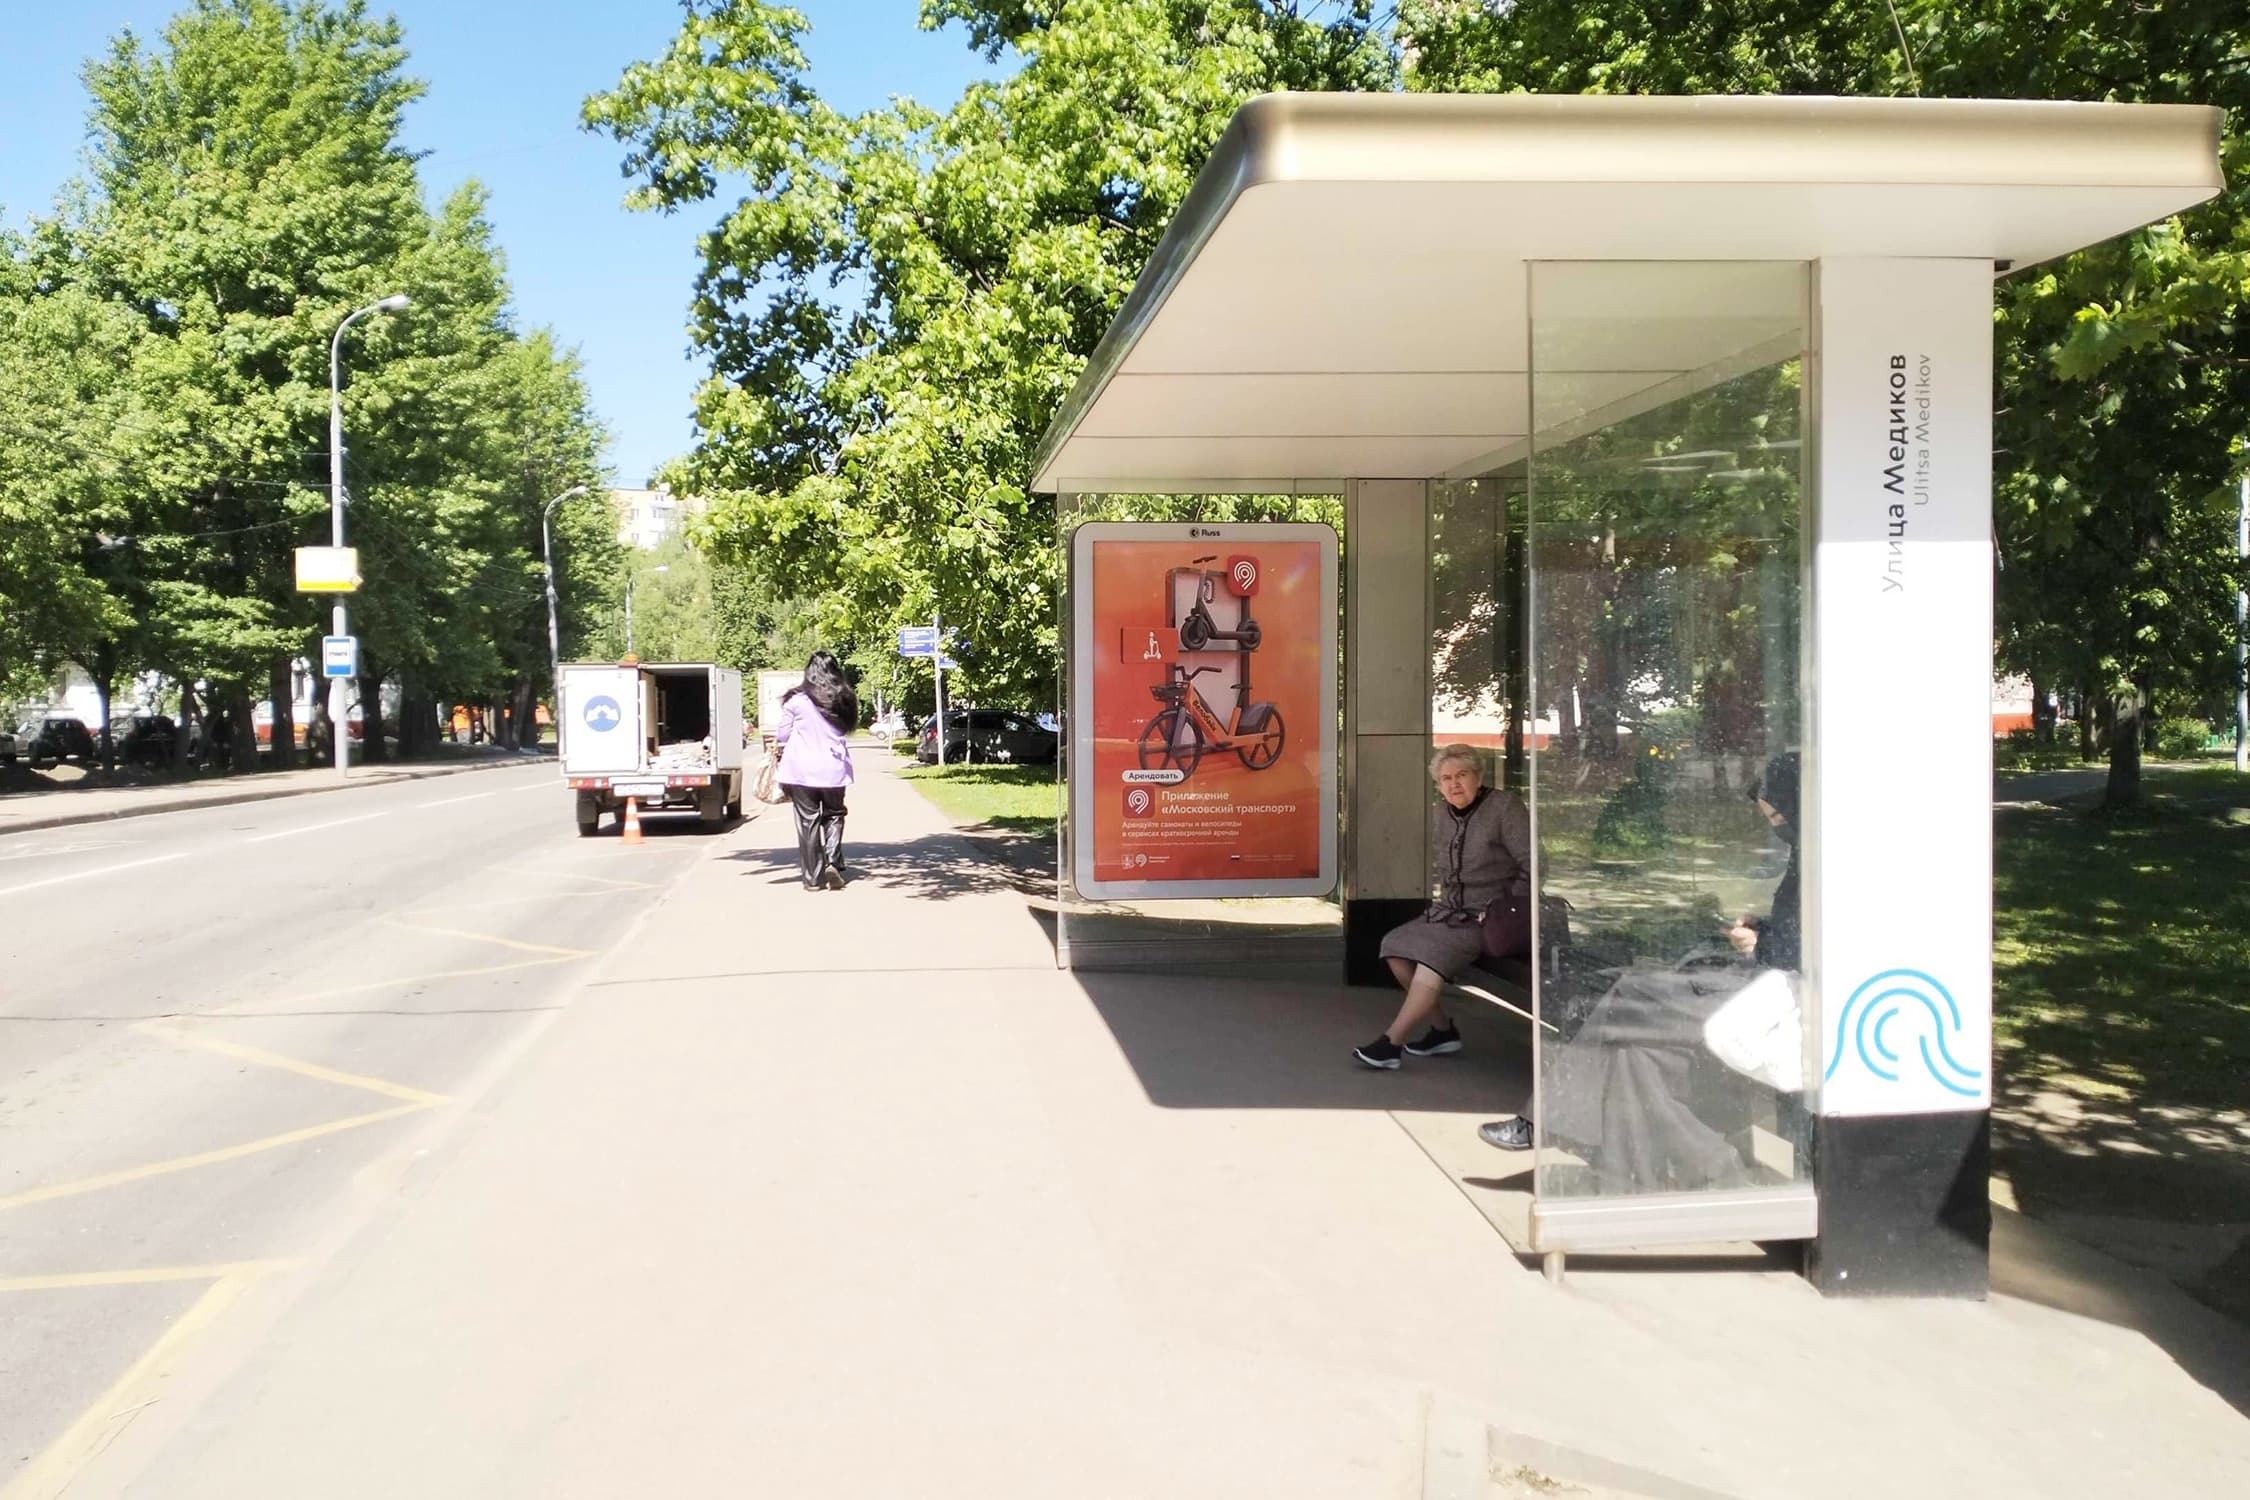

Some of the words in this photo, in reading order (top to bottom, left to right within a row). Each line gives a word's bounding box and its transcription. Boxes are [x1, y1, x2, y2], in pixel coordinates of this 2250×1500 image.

[1883, 354, 1909, 495] Медиков
[1915, 354, 1932, 442] Medikov
[1914, 448, 1930, 505] Ulitsa
[1201, 528, 1221, 537] Russ
[1882, 503, 1908, 592] Улица
[1128, 771, 1179, 781] Арендовать
[1161, 790, 1230, 803] Приложение
